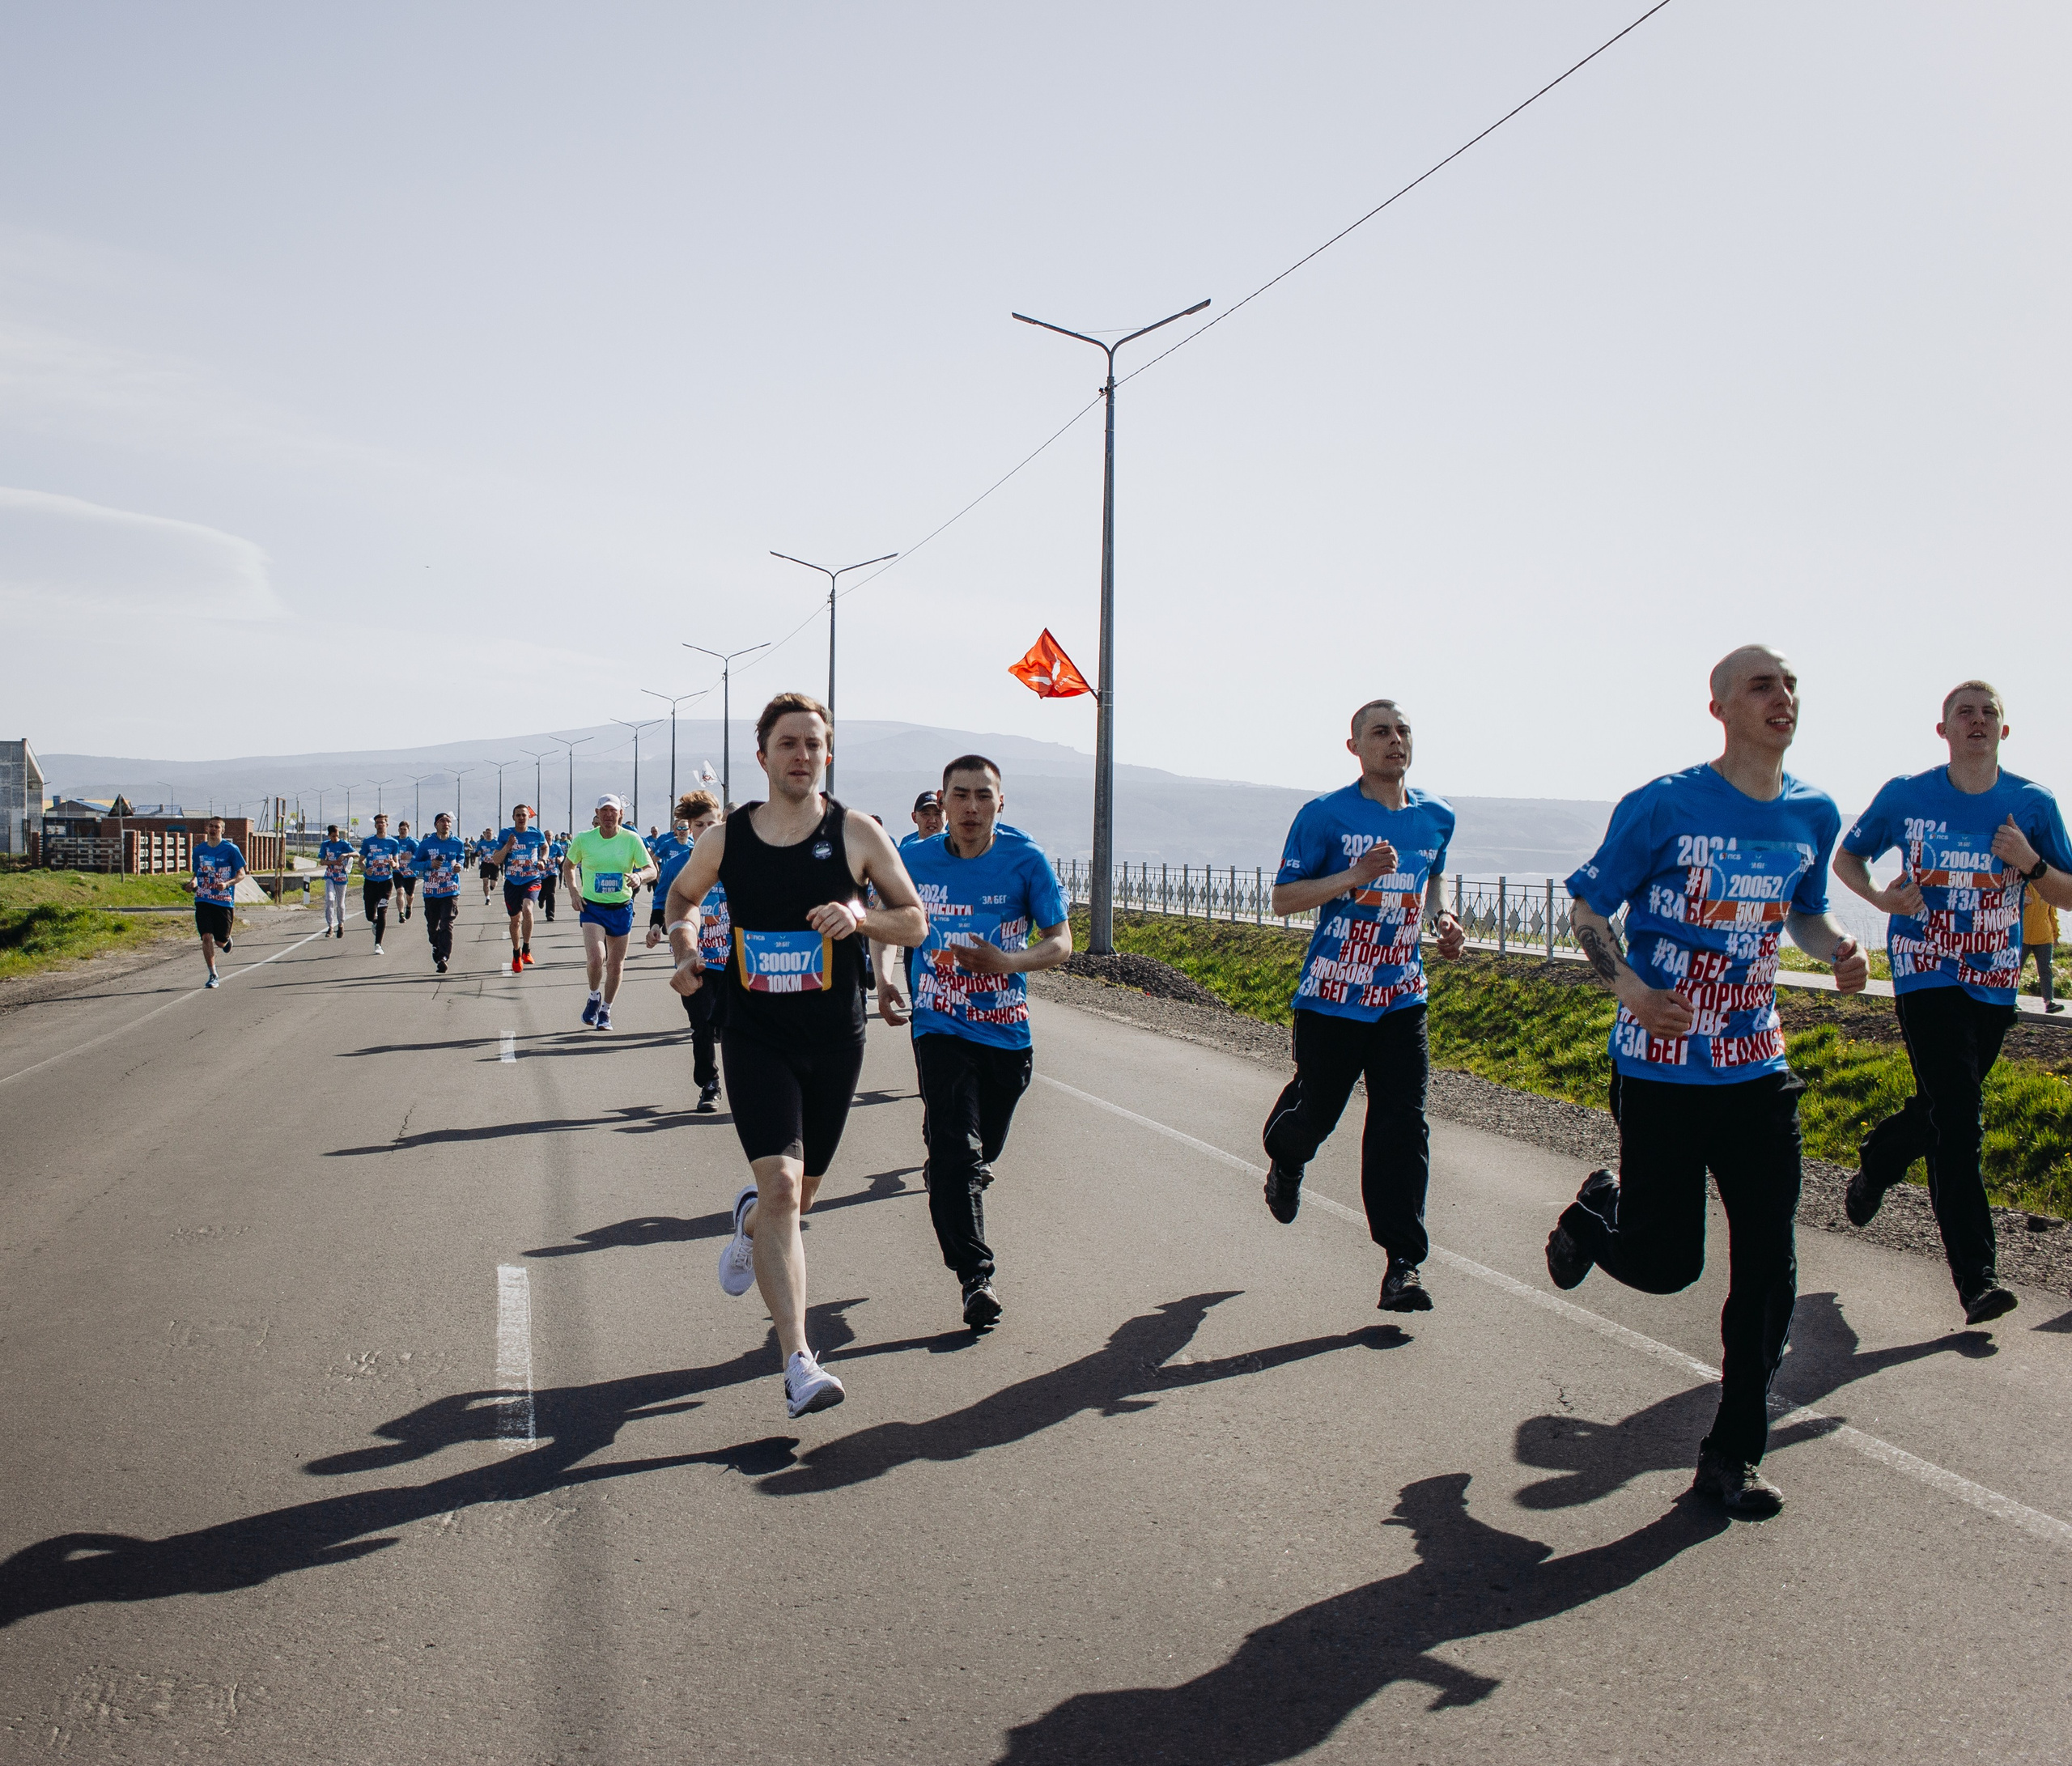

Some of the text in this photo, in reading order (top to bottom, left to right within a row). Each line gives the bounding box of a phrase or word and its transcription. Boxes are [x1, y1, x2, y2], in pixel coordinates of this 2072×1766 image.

[1579, 863, 1599, 879] СБ
[1939, 851, 1990, 871] 20043
[1374, 873, 1414, 889] 20060
[1727, 875, 1783, 898] 20052
[918, 884, 948, 902] 2024
[1324, 916, 1381, 945] #ЗАБЕГ
[759, 951, 811, 972] 30007
[1651, 937, 1732, 982] #ЗАБЕГ
[767, 974, 802, 992] 10KM
